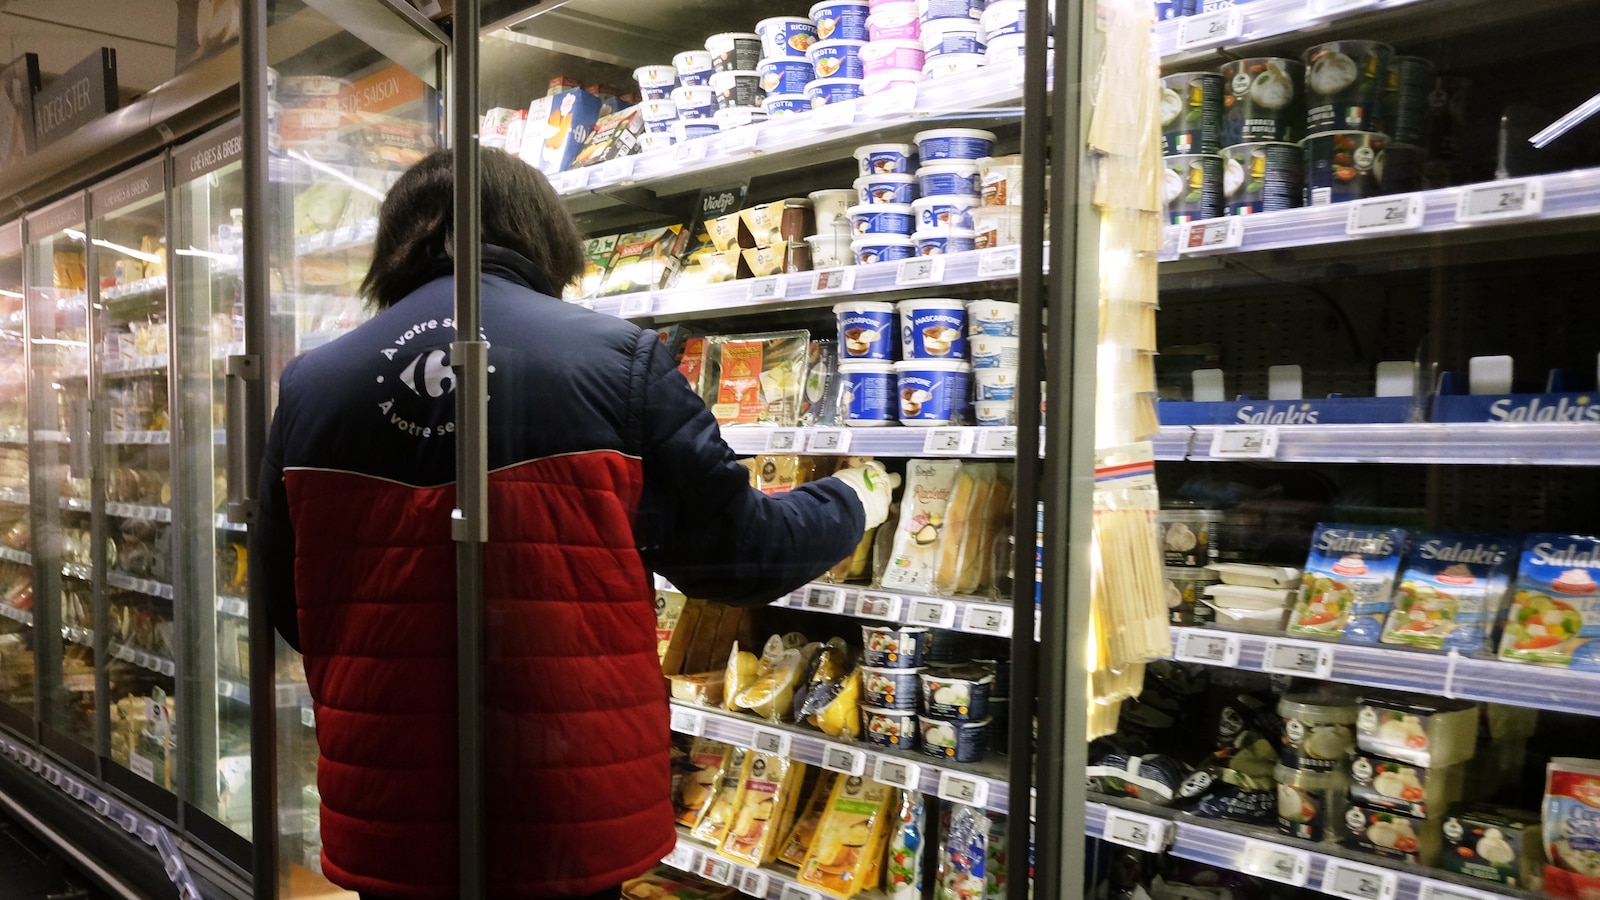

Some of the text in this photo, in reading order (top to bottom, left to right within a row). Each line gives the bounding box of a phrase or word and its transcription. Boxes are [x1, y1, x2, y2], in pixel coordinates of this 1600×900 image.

[363, 75, 399, 107] SAISON
[703, 193, 735, 213] Violife
[394, 319, 439, 347] votre
[841, 317, 881, 329] MASCARPONE
[915, 313, 961, 327] MASCARPONE
[1235, 404, 1320, 425] Salakis
[1488, 396, 1600, 423] Salakis
[390, 412, 432, 438] votre
[1317, 528, 1395, 556] Salakis
[1419, 539, 1507, 566] Salakis
